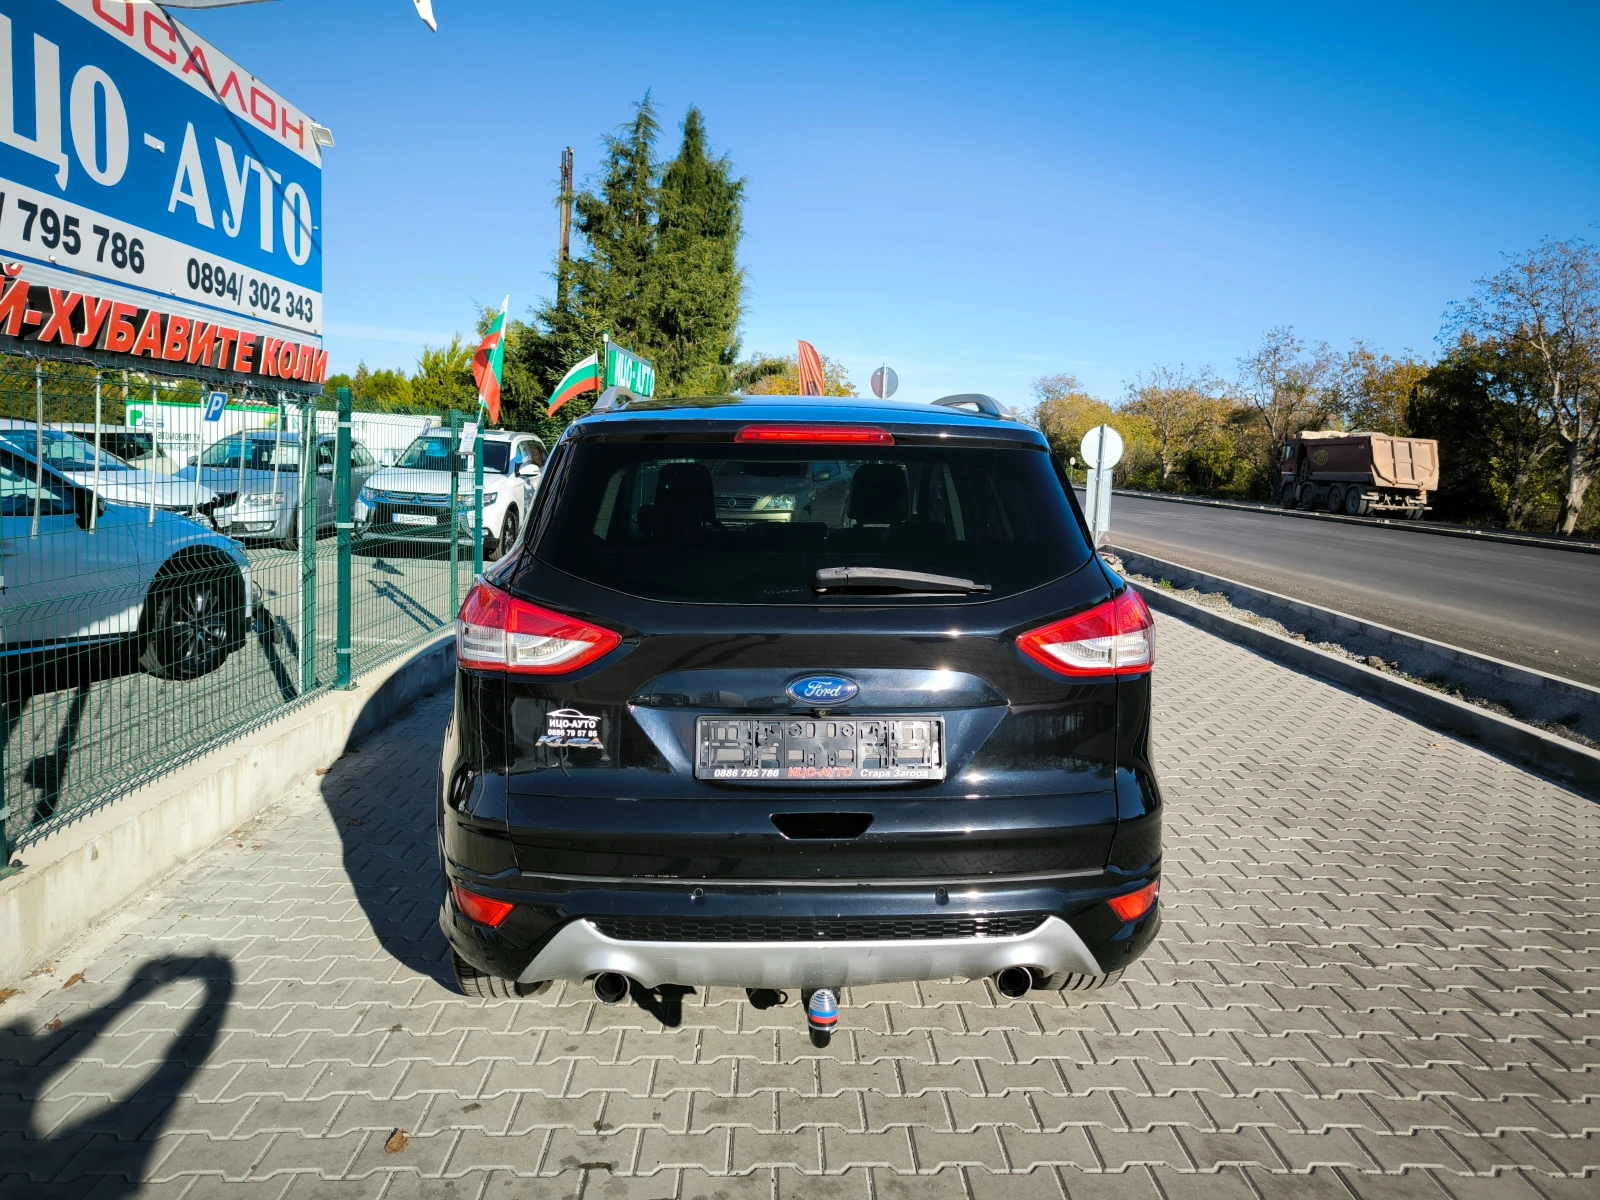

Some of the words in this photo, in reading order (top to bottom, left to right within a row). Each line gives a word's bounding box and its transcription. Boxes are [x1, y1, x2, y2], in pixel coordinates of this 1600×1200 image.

[17, 198, 82, 257] 795
[92, 223, 145, 274] 786
[186, 258, 244, 306] 0894/
[249, 280, 281, 314] 302
[285, 296, 313, 323] 343
[259, 335, 329, 385] КОЛИ
[804, 680, 842, 697] Ford
[549, 719, 596, 729] ИЦО-АУТО
[714, 769, 738, 778] 0886
[741, 769, 759, 778] 795
[761, 769, 779, 778] 786
[787, 767, 852, 779] ИЦО-АУТО
[860, 769, 891, 779] Стара
[892, 769, 929, 779] Загора
